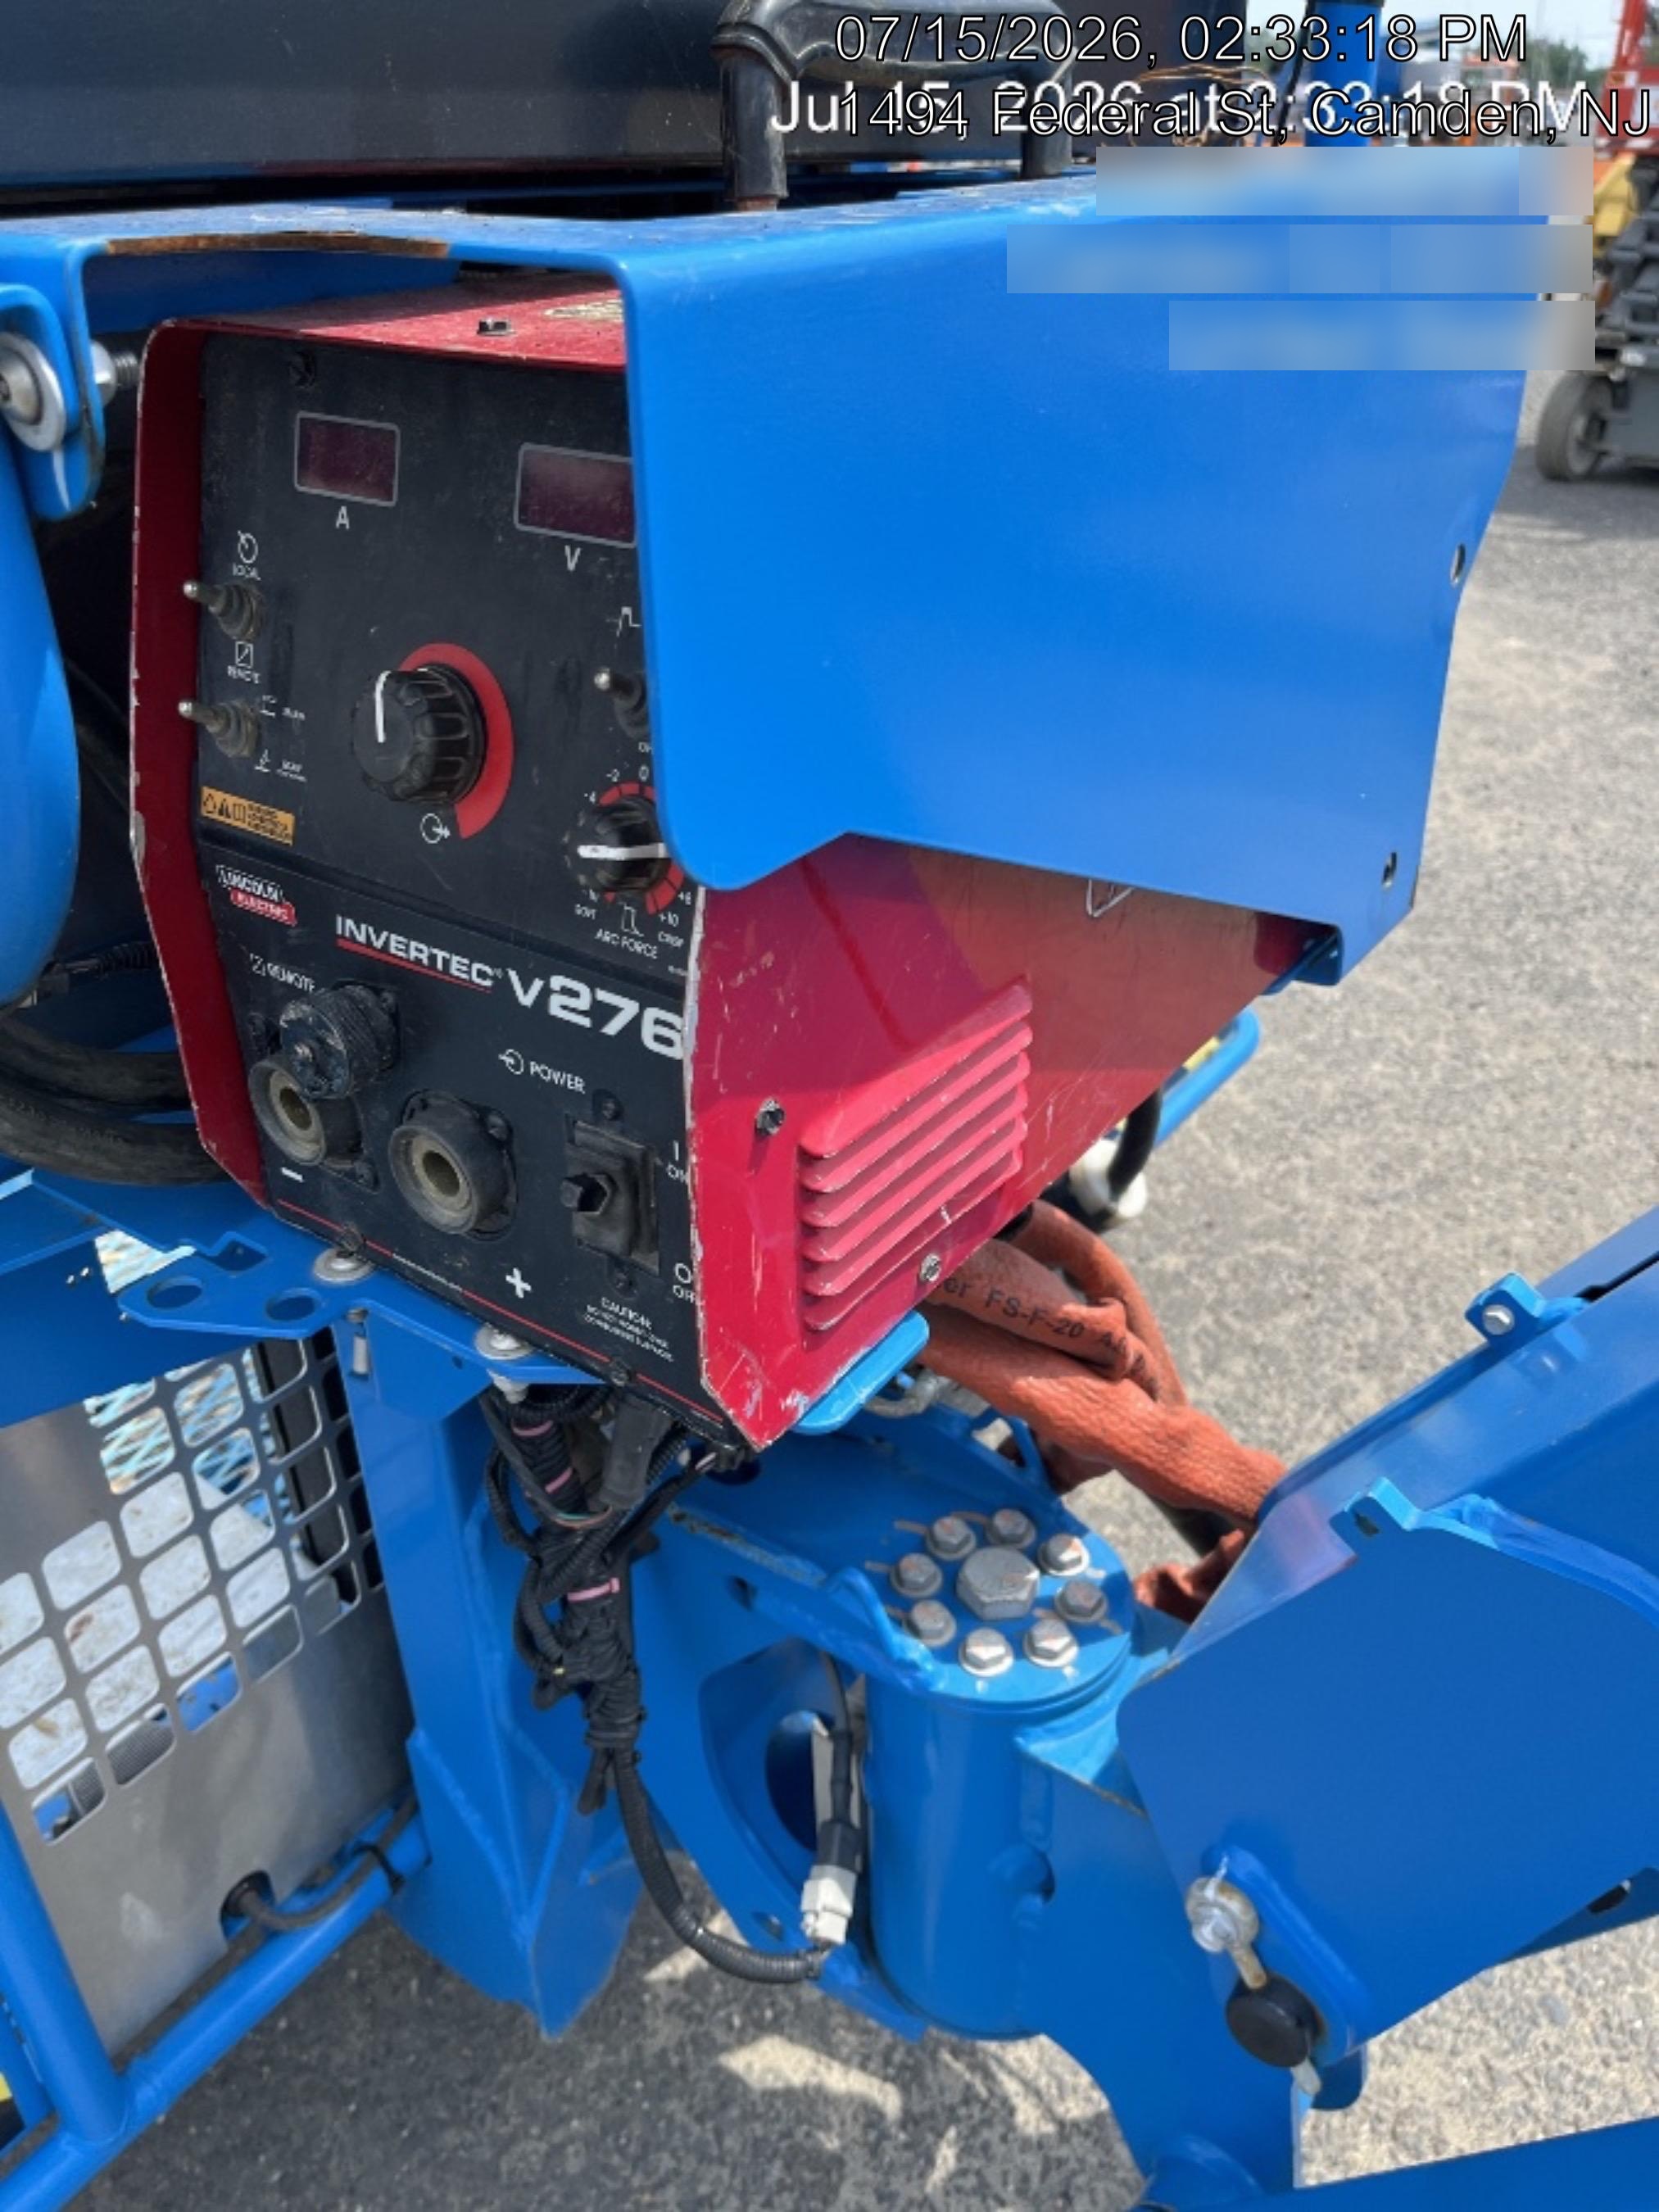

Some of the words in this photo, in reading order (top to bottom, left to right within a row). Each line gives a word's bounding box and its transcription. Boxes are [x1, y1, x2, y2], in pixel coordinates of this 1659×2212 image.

[335, 505, 351, 530] A
[564, 544, 582, 572] V
[594, 927, 620, 946] ARC
[620, 936, 658, 960] FORCE
[505, 966, 683, 1061] V276
[529, 1061, 586, 1095] POWER
[941, 1276, 972, 1299] er
